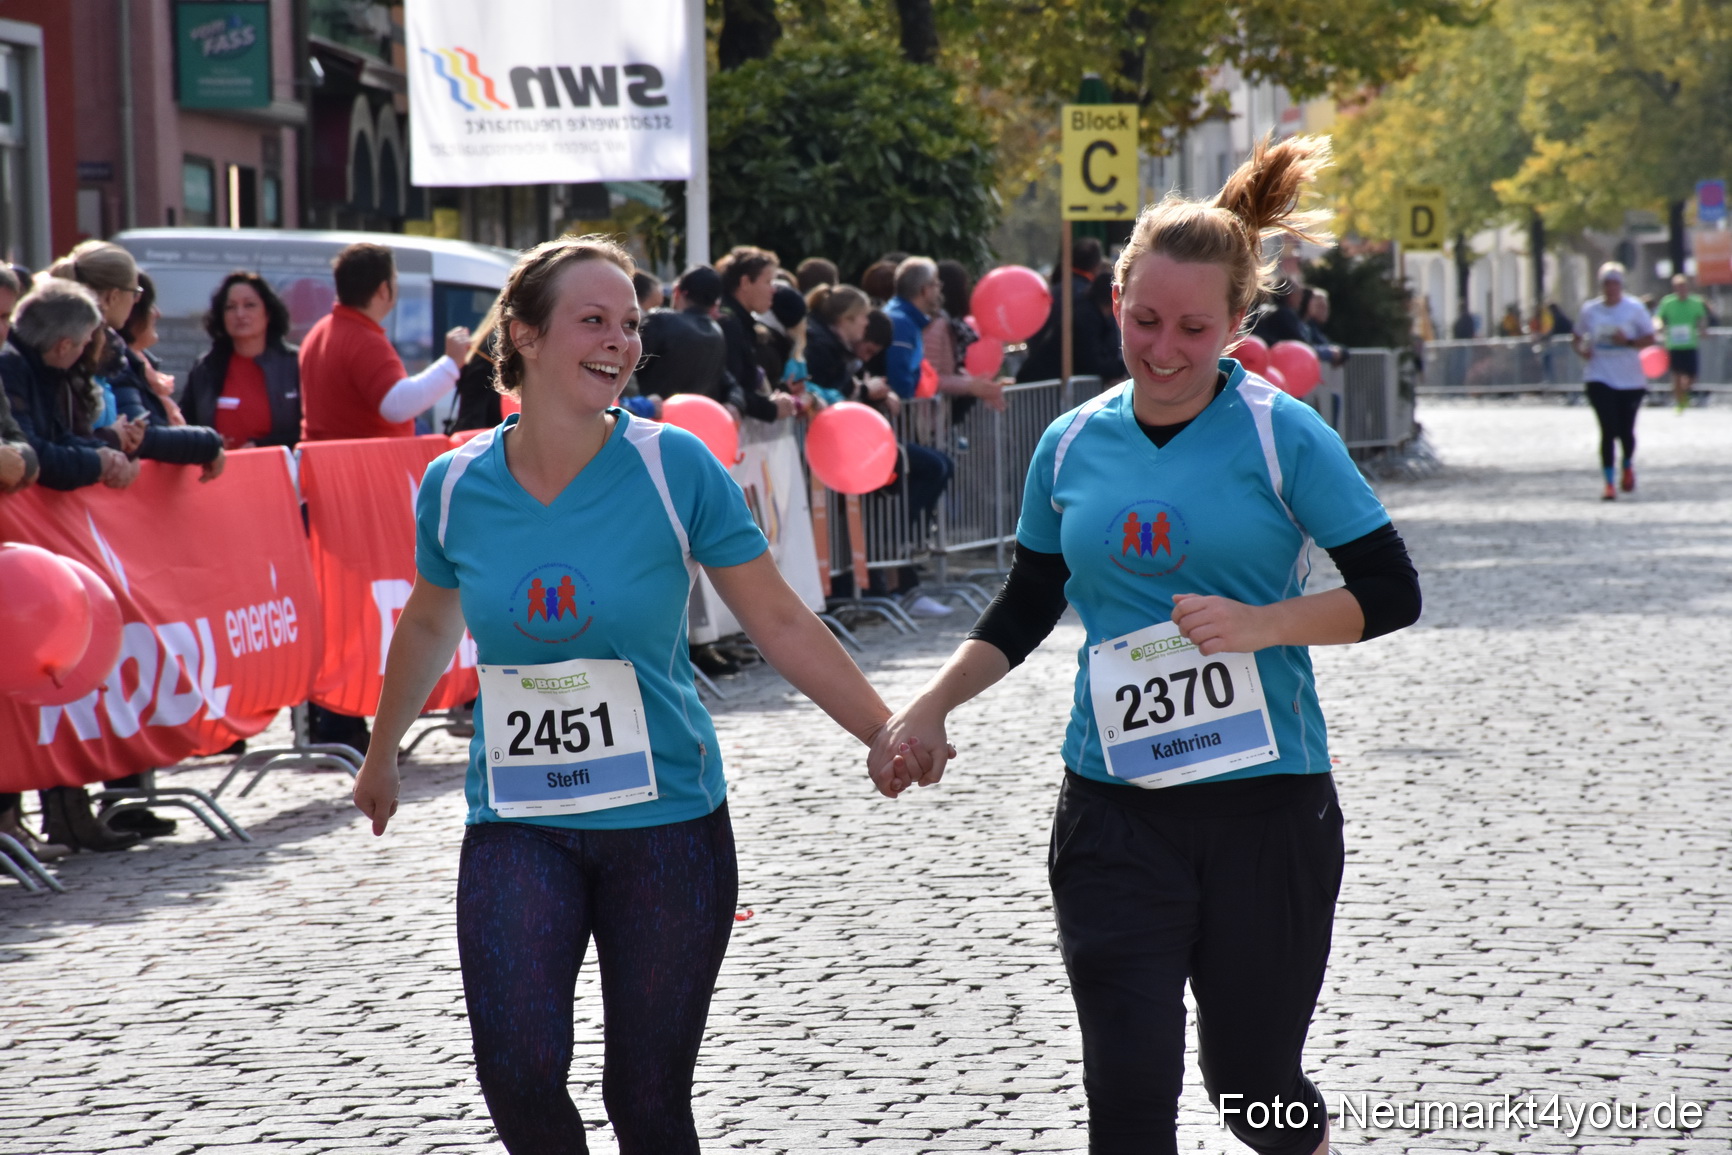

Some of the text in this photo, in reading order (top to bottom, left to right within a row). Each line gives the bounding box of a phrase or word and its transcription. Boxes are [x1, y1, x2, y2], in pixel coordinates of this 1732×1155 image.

[202, 24, 257, 57] FASS
[1071, 110, 1129, 131] Block
[1082, 140, 1118, 195] C
[1411, 205, 1435, 238] D
[225, 594, 299, 659] energie
[534, 672, 589, 690] BOCK
[1115, 661, 1235, 732] 2370
[507, 702, 614, 756] 2451
[1108, 730, 1114, 739] D
[494, 751, 500, 760] D
[1151, 731, 1222, 760] Kathrina
[546, 768, 590, 788] Steffi
